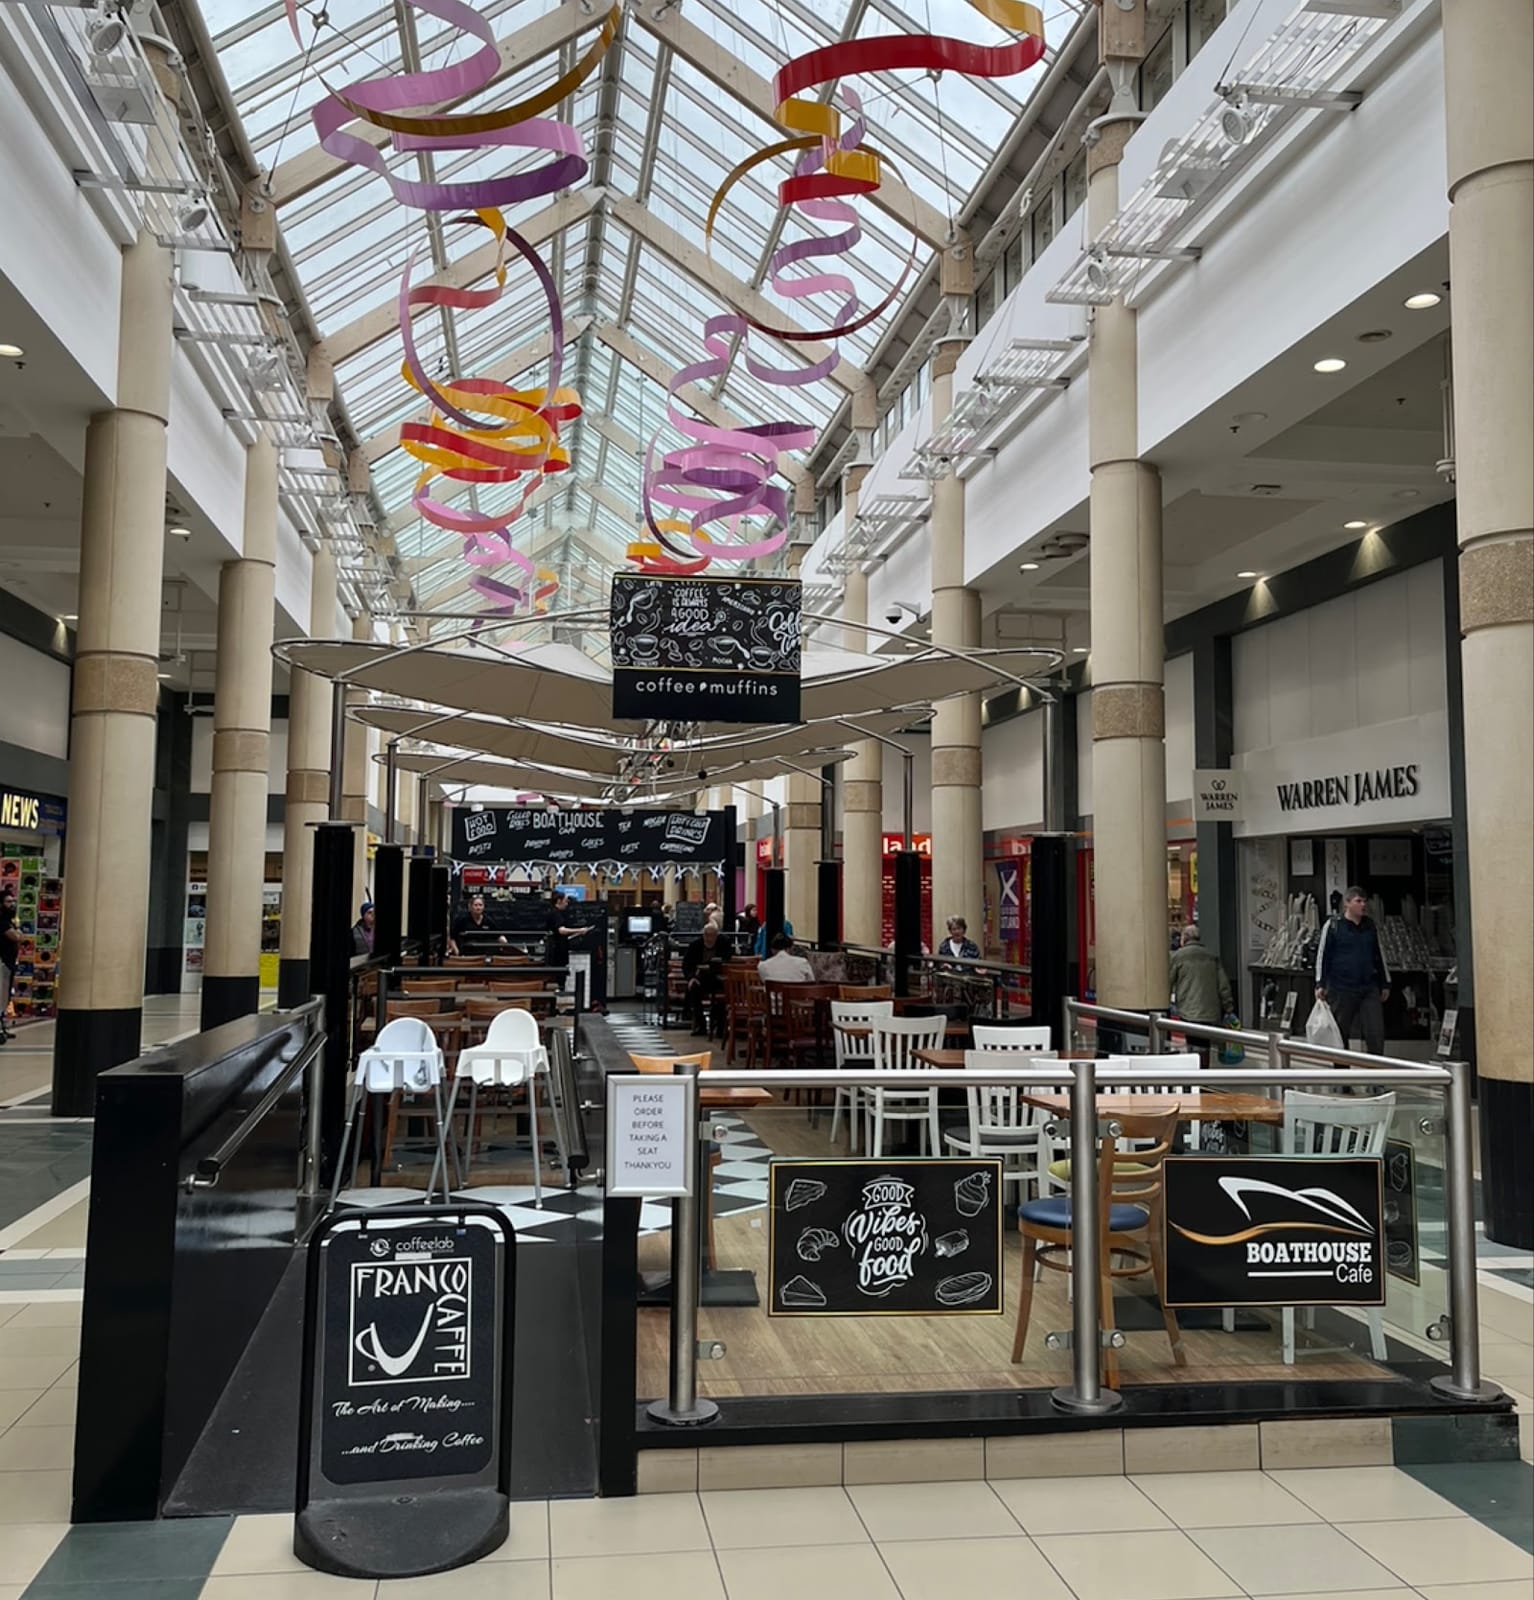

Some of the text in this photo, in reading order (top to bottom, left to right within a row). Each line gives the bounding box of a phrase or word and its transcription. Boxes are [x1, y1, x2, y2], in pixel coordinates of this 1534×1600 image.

[674, 587, 705, 598] COFFEE
[672, 598, 680, 607] IS
[671, 607, 709, 620] A GOOD
[663, 617, 716, 633] idea
[635, 677, 778, 696] coffee muffins
[1277, 764, 1418, 812] WARREN JAMES
[1200, 792, 1239, 801] WARREN
[1, 793, 40, 830] NEWS
[1206, 801, 1235, 811] JAMES
[469, 814, 488, 829] HOT
[533, 811, 604, 828] BOATHOUSE
[470, 823, 494, 838] FOOD
[633, 1094, 664, 1103] PLEASE
[632, 1121, 664, 1129] BEFORE
[629, 1134, 667, 1142] TAKING A
[637, 1147, 658, 1155] SEAT
[872, 1186, 905, 1203] GOOD
[850, 1205, 921, 1243] Vibes
[395, 1236, 454, 1252] coffeelab
[873, 1236, 904, 1251] GOOD
[1246, 1242, 1372, 1263] BOATHOUSE
[859, 1237, 921, 1286] food
[357, 1263, 467, 1298] FRANCO
[1335, 1263, 1373, 1283] Cafe
[434, 1293, 467, 1373] CAFFE
[332, 1400, 355, 1417] The
[357, 1398, 389, 1414] Art
[390, 1399, 405, 1413] of
[379, 1433, 438, 1453] Drinking
[442, 1432, 484, 1448] Coffee
